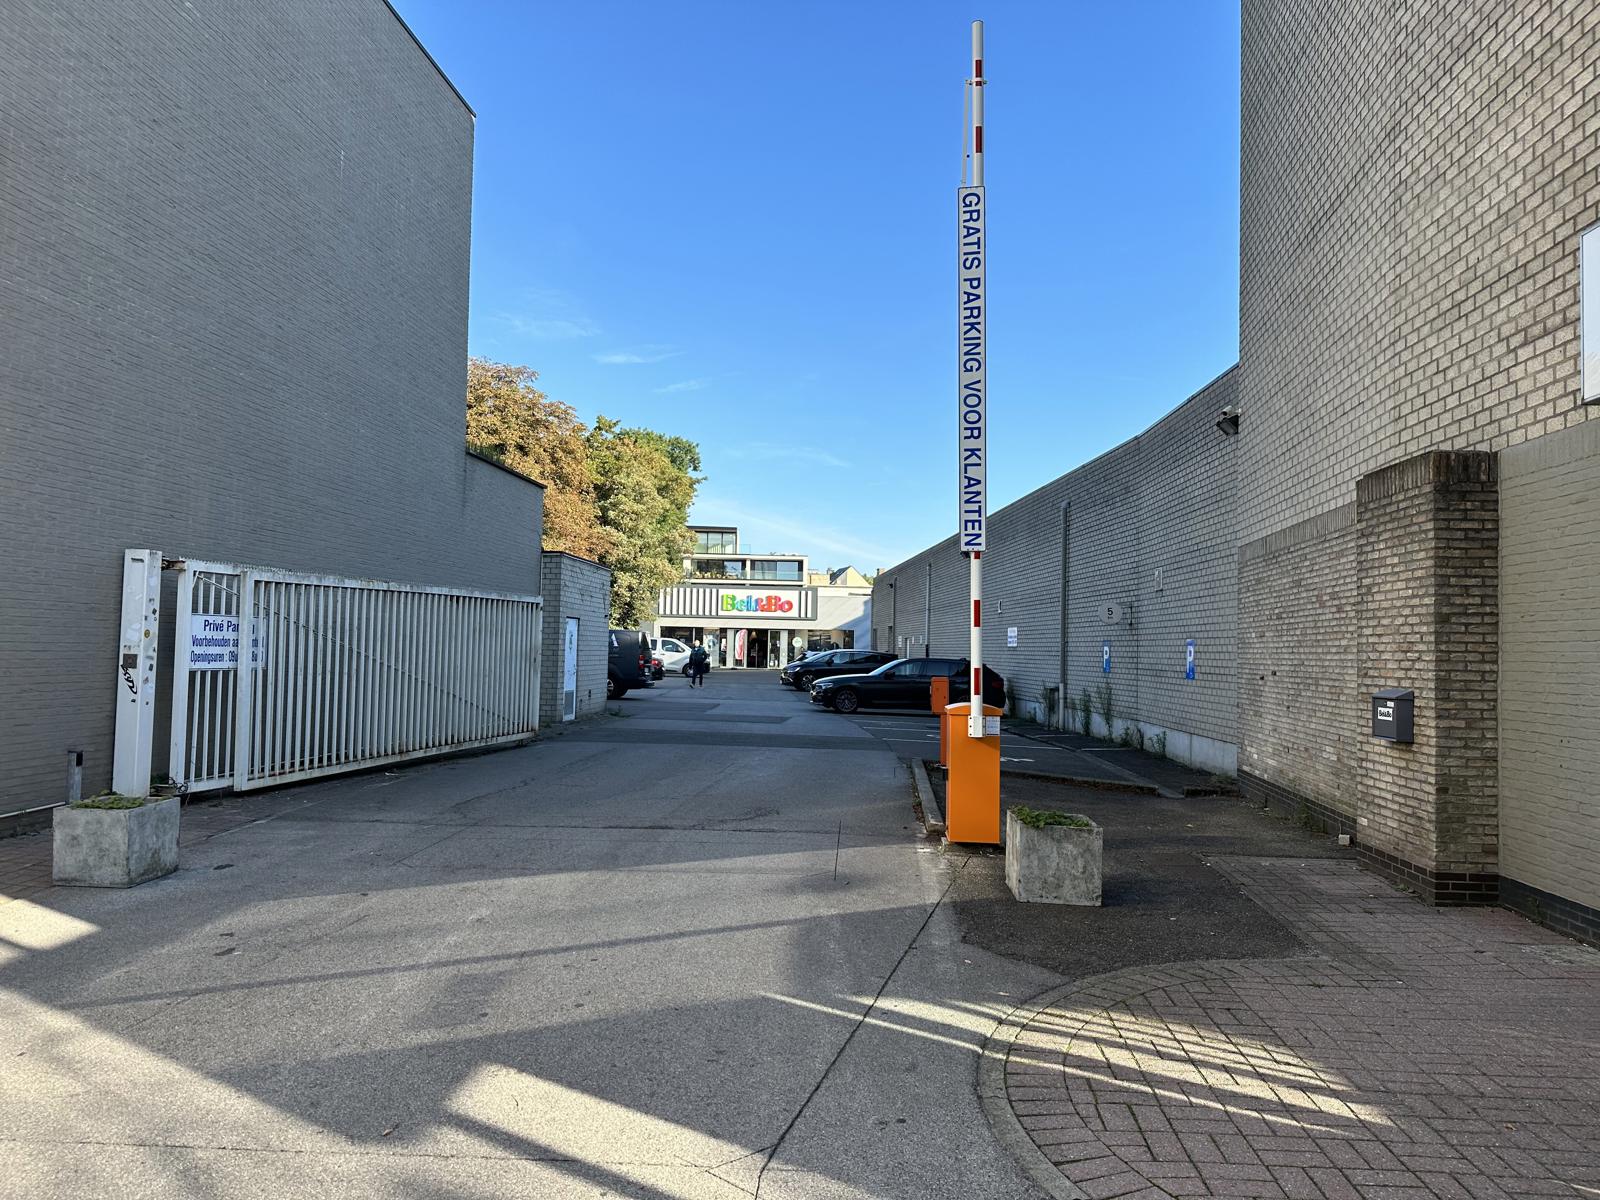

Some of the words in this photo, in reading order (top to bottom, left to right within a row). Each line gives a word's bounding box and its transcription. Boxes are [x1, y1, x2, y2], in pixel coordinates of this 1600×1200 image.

[962, 193, 981, 270] GRATIS
[963, 277, 982, 373] PARKING
[963, 379, 982, 440] VOOR
[963, 448, 982, 547] KLANTEN
[203, 619, 224, 632] Privé
[1107, 607, 1114, 616] 5
[191, 634, 231, 647] Voorbehouden
[191, 650, 224, 665] Openingsuren
